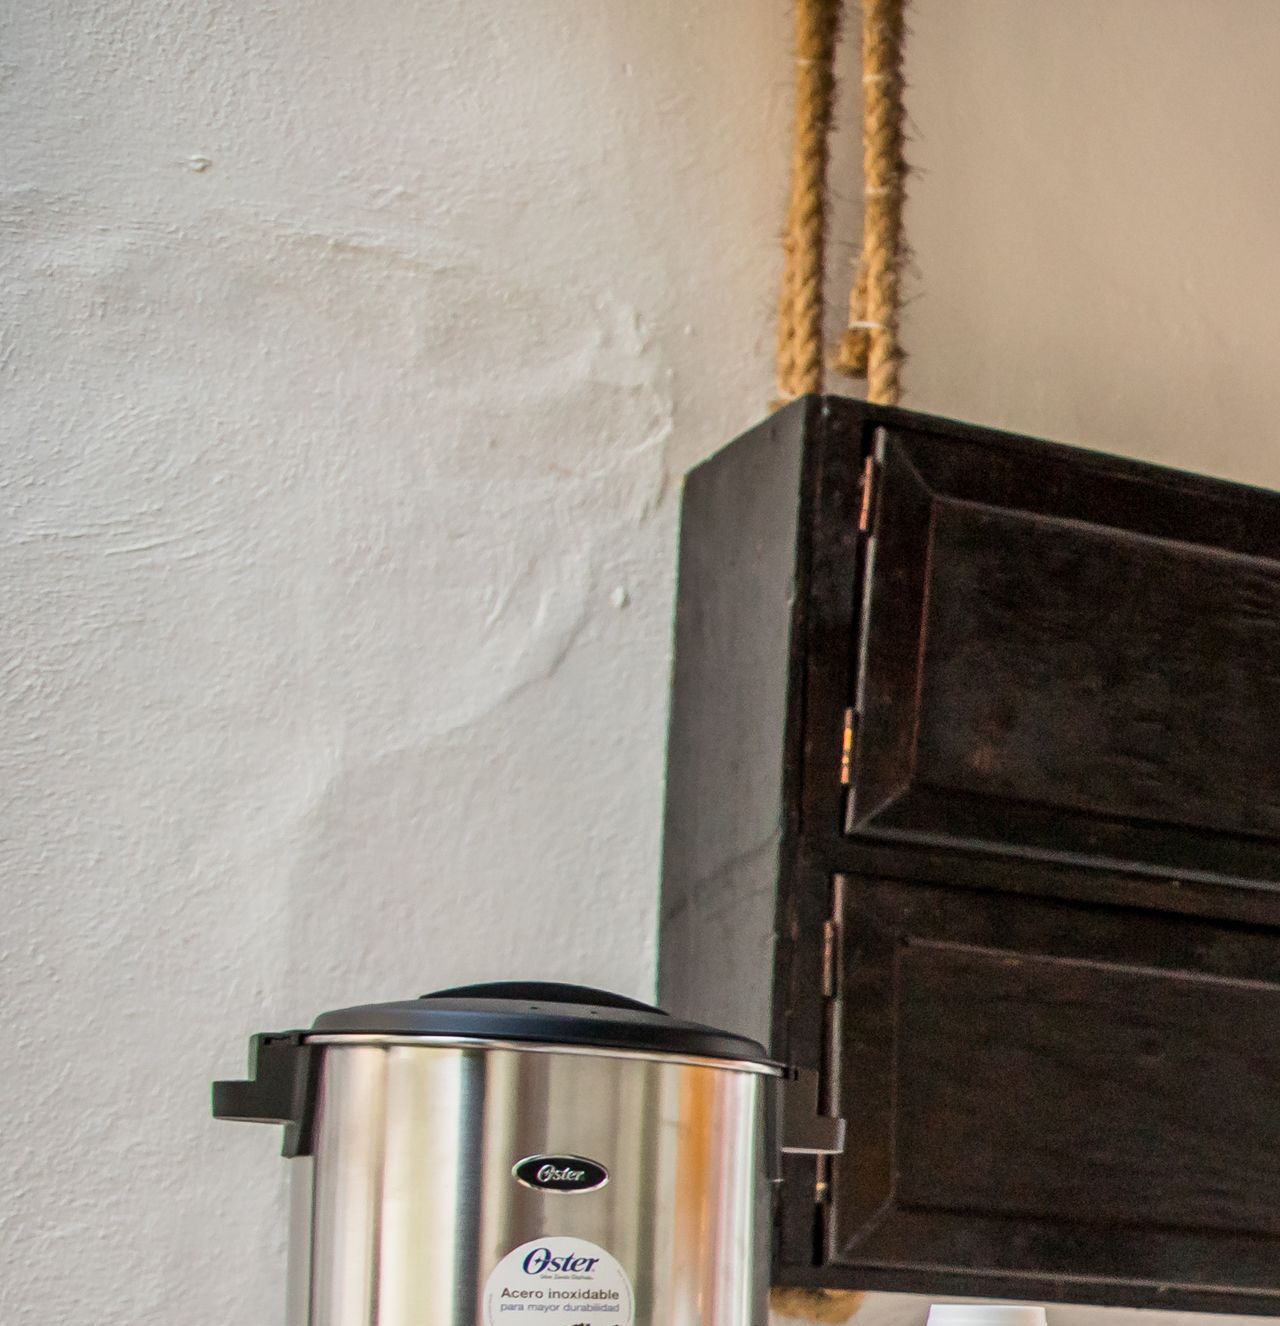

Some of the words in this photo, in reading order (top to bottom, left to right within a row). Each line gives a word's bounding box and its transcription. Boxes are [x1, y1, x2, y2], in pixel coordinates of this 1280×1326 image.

[537, 1164, 584, 1182] Oster
[522, 1247, 600, 1275] Oster
[500, 1287, 544, 1299] Acero
[548, 1287, 620, 1300] inoxidable
[500, 1303, 524, 1313] para
[527, 1303, 560, 1313] mayor
[563, 1302, 620, 1313] durabilidad
